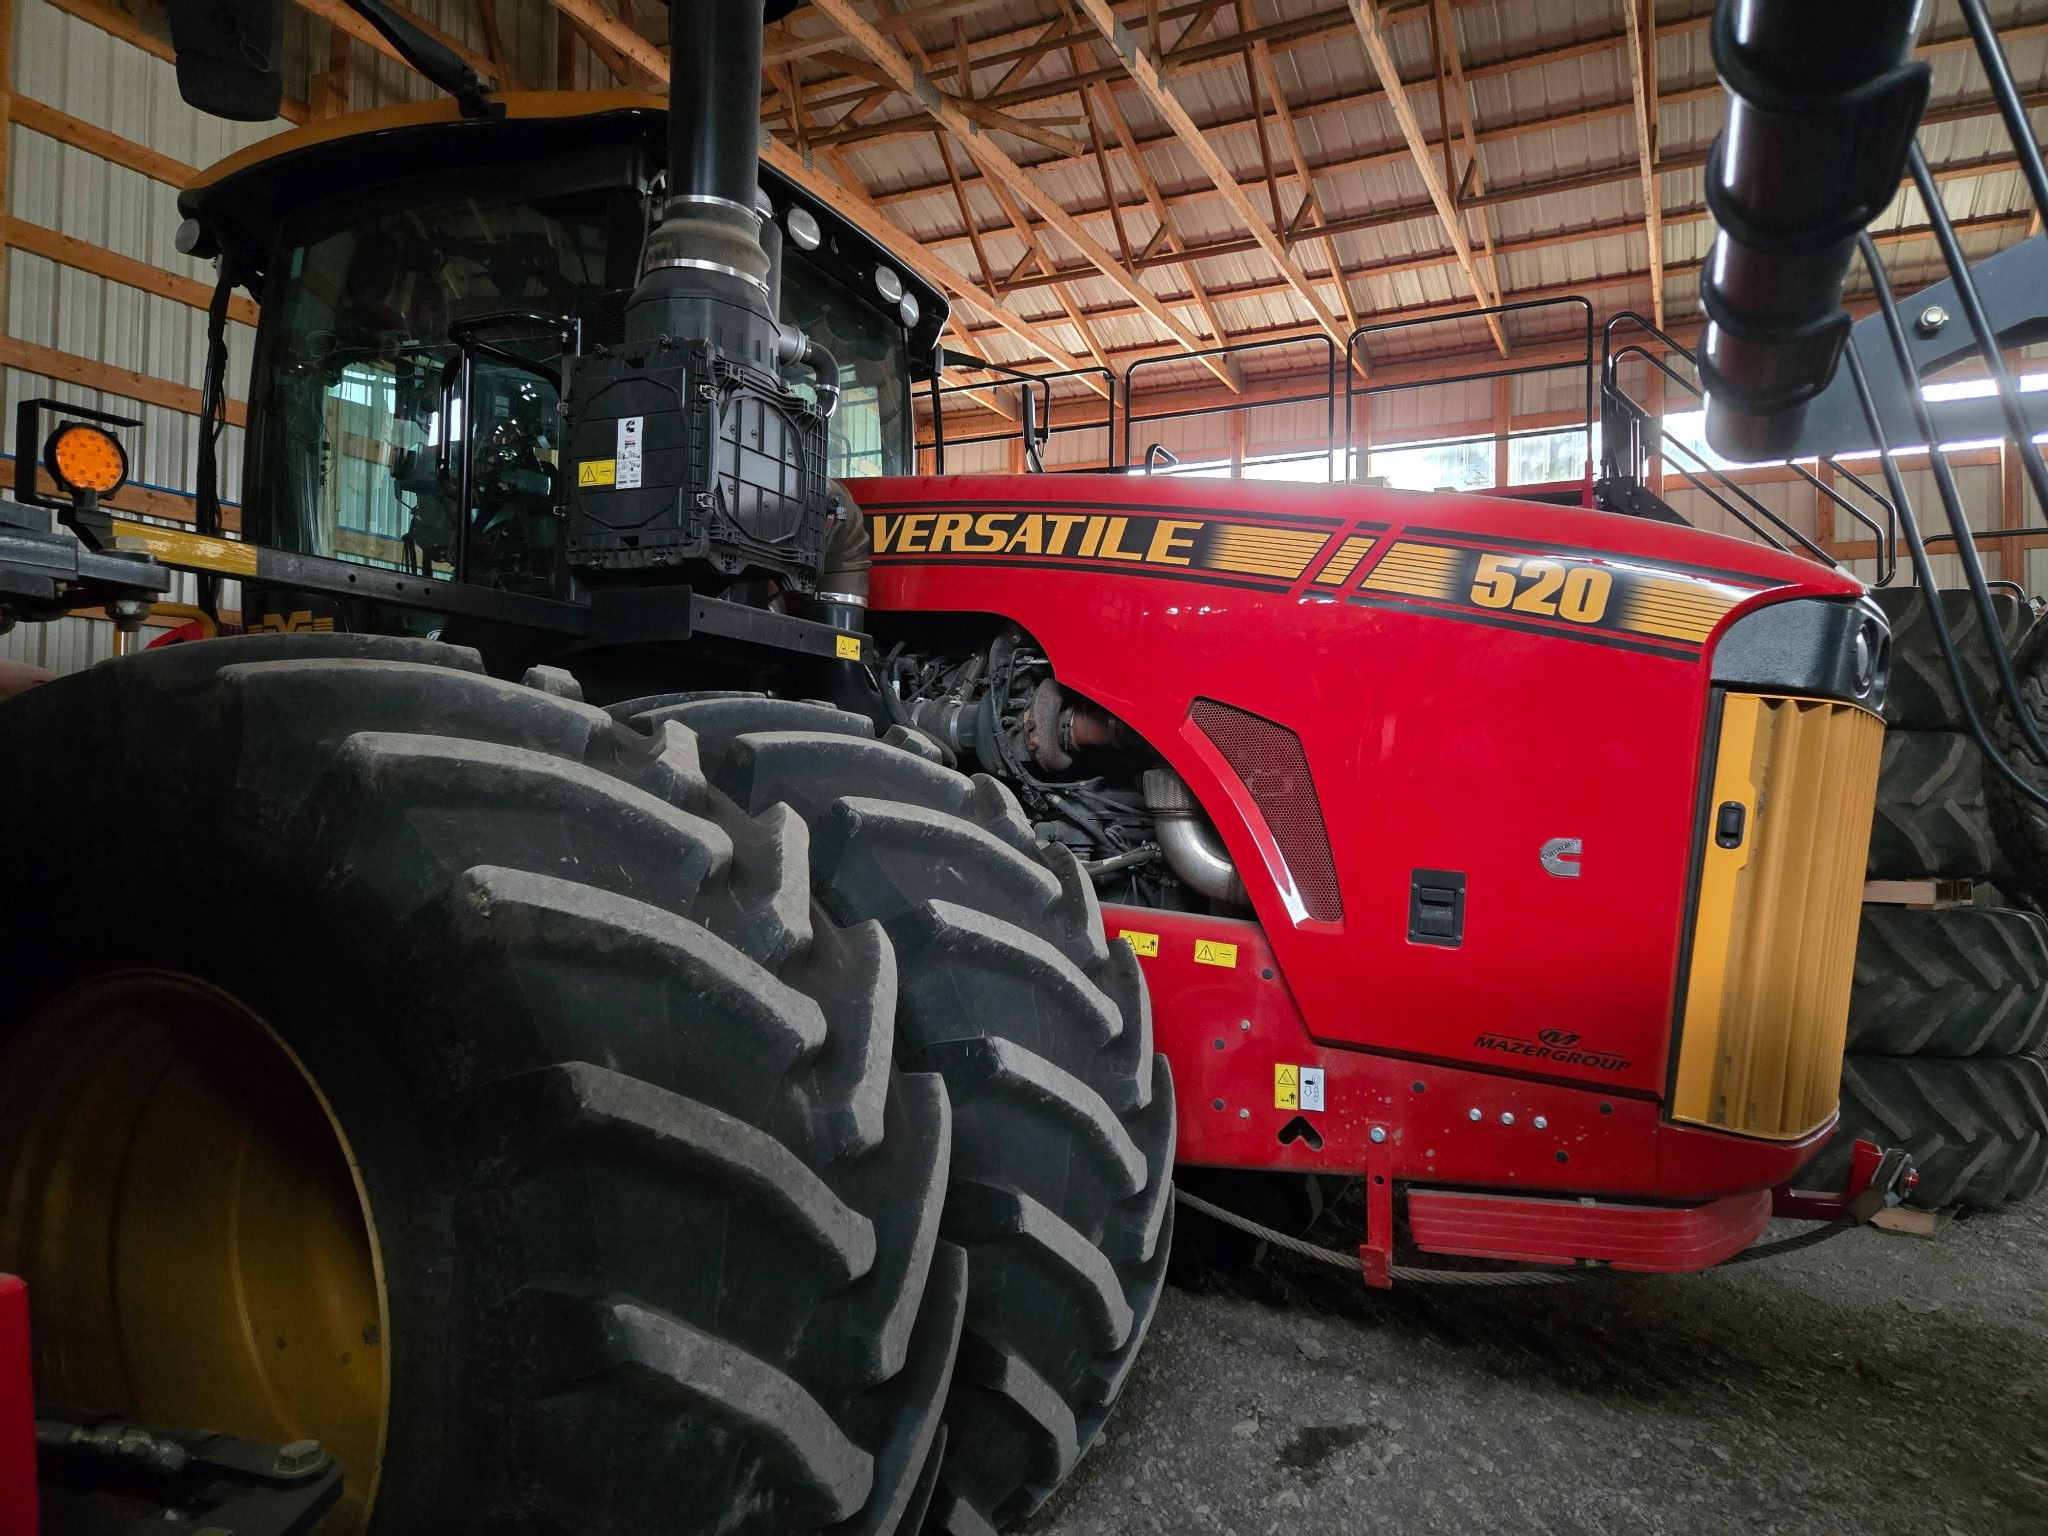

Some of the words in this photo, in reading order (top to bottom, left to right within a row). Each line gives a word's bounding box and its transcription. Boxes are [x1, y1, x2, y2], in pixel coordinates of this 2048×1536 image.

[873, 513, 1205, 566] VERSATILE
[1470, 553, 1613, 624] 520
[1473, 1036, 1632, 1073] MAZERGROUP
